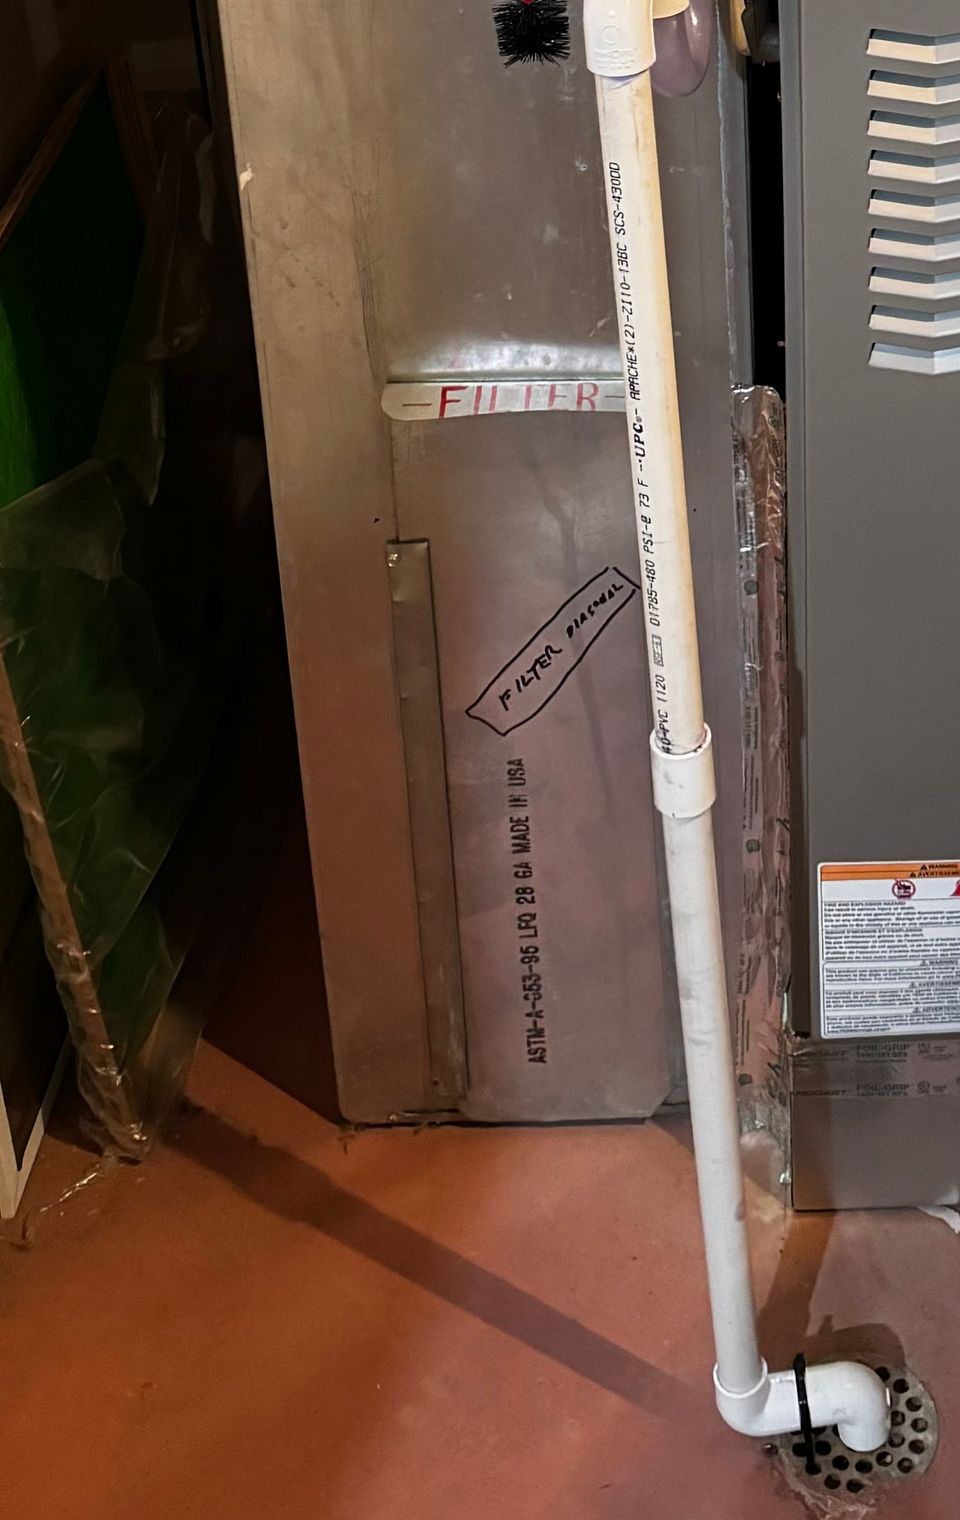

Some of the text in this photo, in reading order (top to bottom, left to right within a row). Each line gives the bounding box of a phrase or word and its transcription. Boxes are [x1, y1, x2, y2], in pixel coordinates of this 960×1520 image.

[637, 478, 648, 487] F
[639, 492, 650, 508] 73
[499, 645, 562, 711] FILTER
[507, 758, 527, 788] USA
[508, 794, 528, 808] IN
[509, 816, 531, 855] MADE
[514, 862, 533, 880] GA
[515, 886, 536, 905] 28
[517, 911, 538, 940] LFQ
